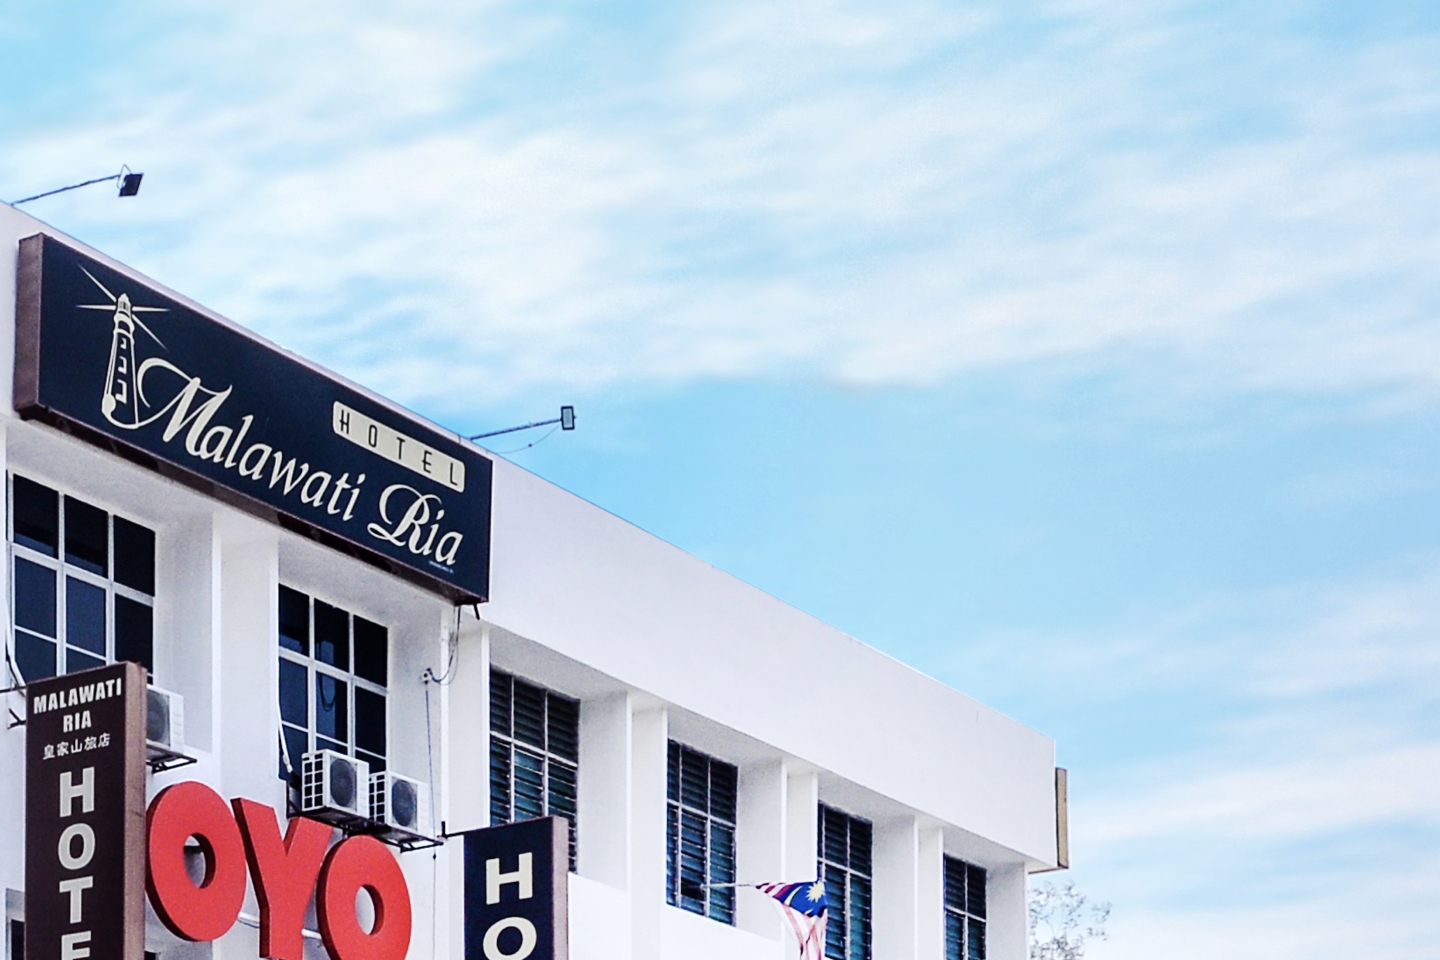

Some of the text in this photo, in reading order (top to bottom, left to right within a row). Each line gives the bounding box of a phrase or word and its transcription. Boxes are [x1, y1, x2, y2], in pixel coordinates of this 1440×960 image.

[137, 357, 463, 565] Malawati Ria
[339, 410, 460, 487] HOTEL
[33, 677, 122, 714] MALAWATI
[63, 710, 92, 732] RIA
